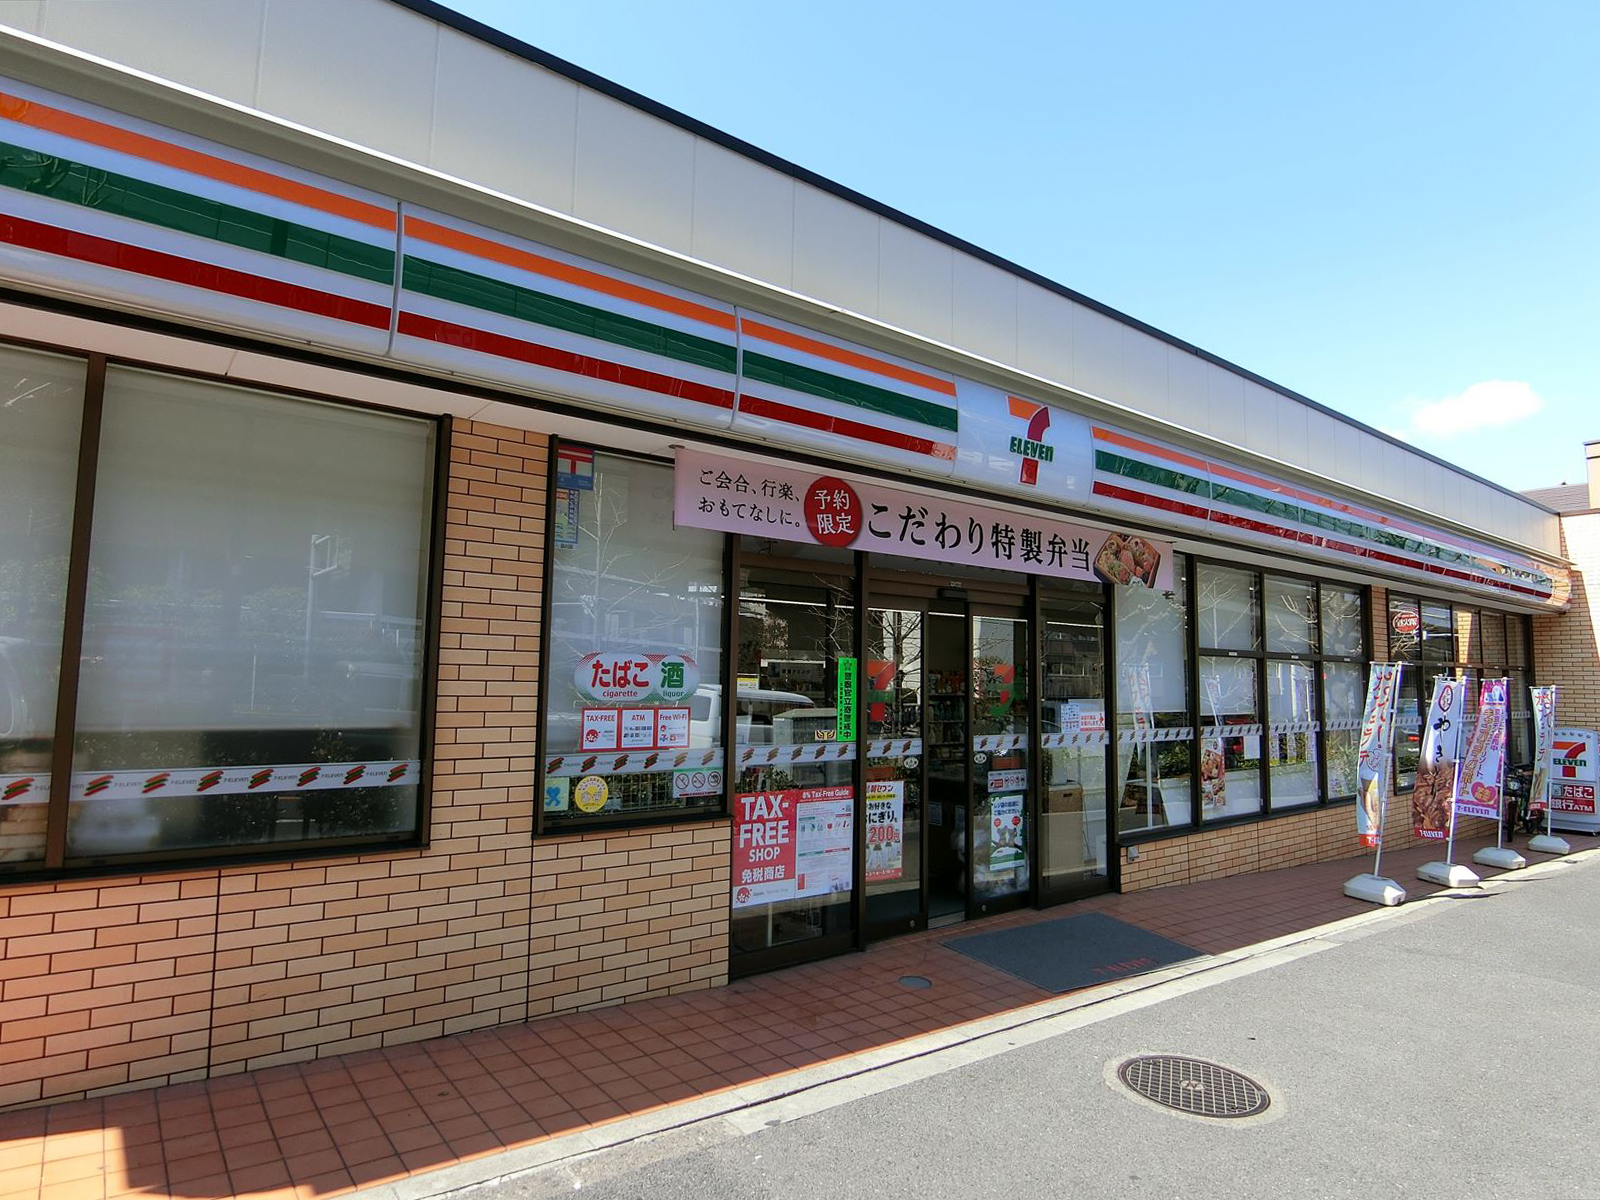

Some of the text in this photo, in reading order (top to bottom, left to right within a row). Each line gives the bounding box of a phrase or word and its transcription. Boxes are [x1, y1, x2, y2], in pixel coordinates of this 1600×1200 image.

[699, 469, 800, 502] ご会合、行楽、
[814, 489, 850, 511] 予約
[698, 496, 800, 528] おもてなしに。
[816, 512, 855, 535] 限定
[868, 502, 1090, 572] こだわり特製弁当
[591, 659, 685, 689] たばこ 酒
[602, 690, 685, 698] cigarette liquor
[586, 714, 615, 722] TAX-FREE
[812, 789, 834, 798] Tax-Free
[835, 788, 849, 796] Guide
[1563, 785, 1594, 798] たばこ
[740, 795, 789, 820] TAX-
[868, 801, 892, 810] お好きな
[739, 820, 789, 848] FREE
[749, 847, 780, 862] SHOP
[742, 865, 785, 884] 免税商店
